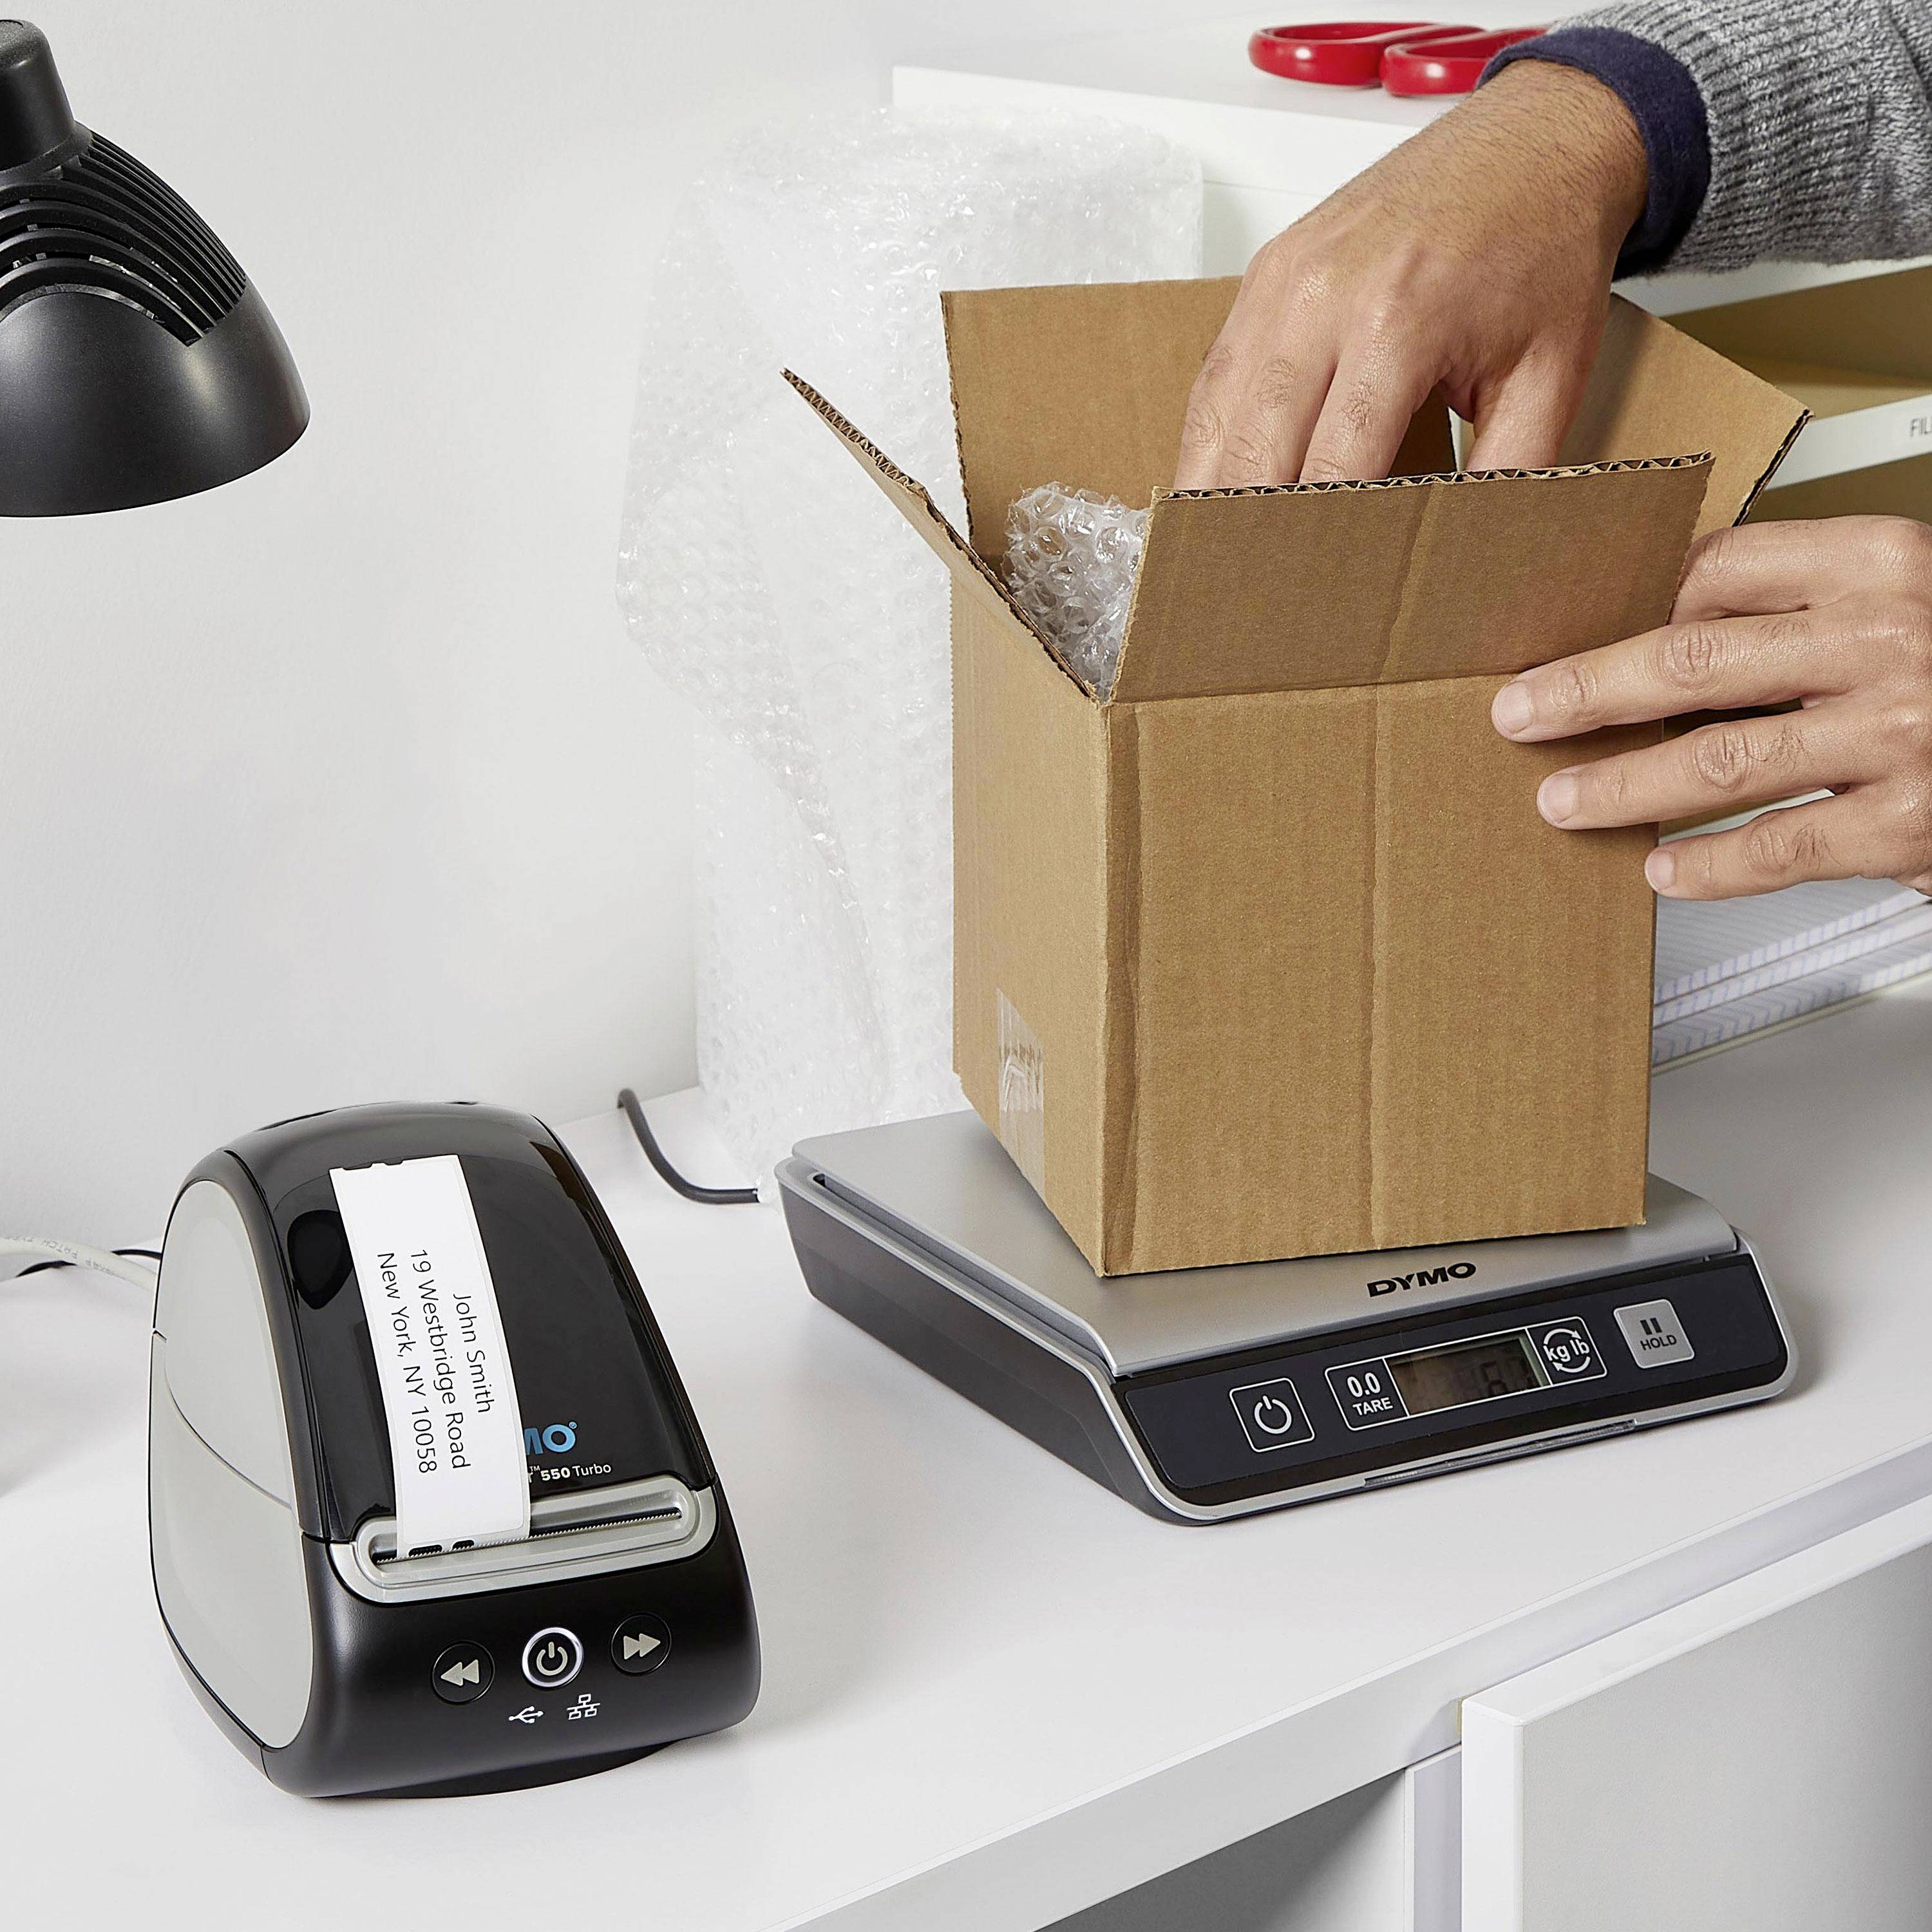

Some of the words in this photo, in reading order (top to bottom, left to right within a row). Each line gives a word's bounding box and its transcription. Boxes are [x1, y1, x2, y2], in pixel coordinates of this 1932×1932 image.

[1909, 416, 1932, 439] FIL
[377, 1253, 401, 1299] New
[410, 1249, 431, 1273] 19
[1367, 1262, 1477, 1297] DYMO
[391, 1306, 416, 1357] York,
[419, 1279, 456, 1404] Westbridge
[1640, 1334, 1677, 1350] HOLD
[453, 1294, 477, 1343] John
[467, 1350, 495, 1412] Smith
[1543, 1345, 1571, 1362] kg
[1569, 1339, 1590, 1355] lb
[403, 1366, 426, 1396] NY
[1347, 1372, 1381, 1397] 0.0
[1352, 1397, 1393, 1416] TARE
[412, 1406, 437, 1473] 10058
[446, 1412, 471, 1468] Road
[540, 1467, 571, 1481] 550
[572, 1463, 611, 1477] Turbo
